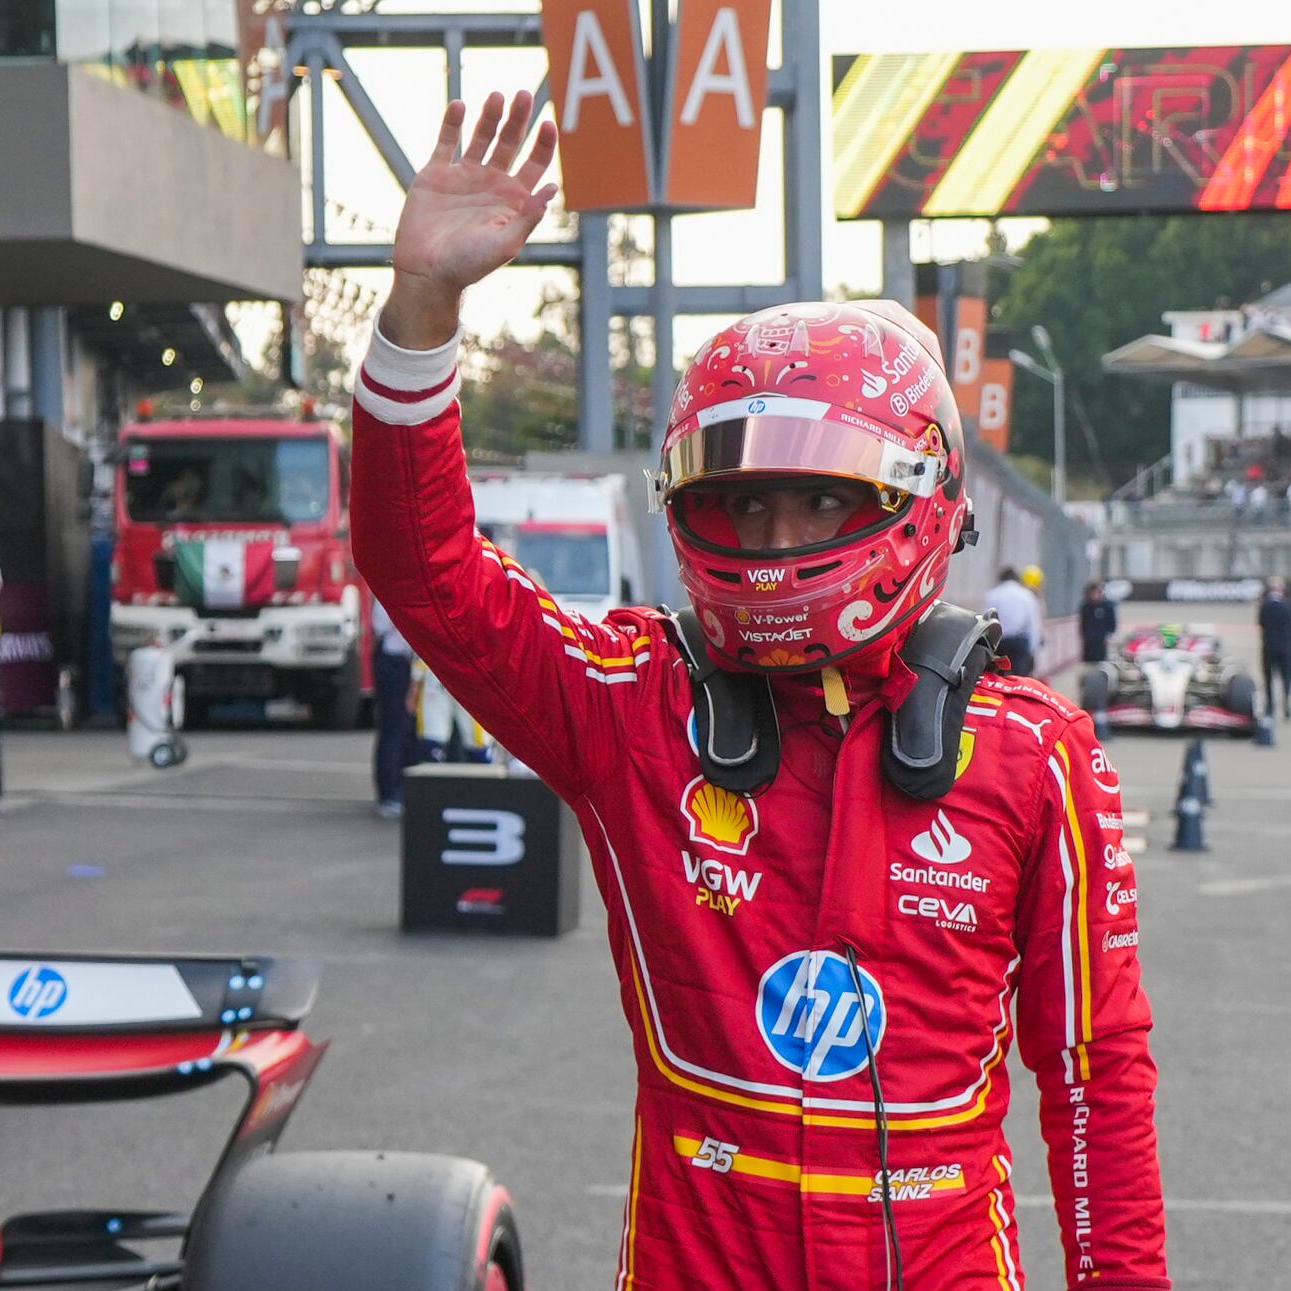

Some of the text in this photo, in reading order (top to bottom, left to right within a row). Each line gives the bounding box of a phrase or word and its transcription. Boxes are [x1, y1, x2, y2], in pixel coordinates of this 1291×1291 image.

[561, 9, 635, 134] A
[680, 6, 756, 130] A
[954, 328, 980, 384] B
[979, 383, 1008, 429] B
[840, 412, 907, 447] RICHARD MILLE
[747, 568, 786, 583] VGW
[755, 582, 778, 592] PLAY
[738, 627, 814, 643] VISTAJET
[752, 611, 809, 625] V-Power
[440, 807, 526, 866] 3
[680, 850, 763, 902] VGW
[889, 862, 991, 894] Santander
[695, 886, 742, 917] PLAY
[935, 918, 977, 933] LOGISTICS
[8, 965, 67, 1018] hp
[761, 952, 881, 1079] hp
[692, 1136, 740, 1174] 55
[874, 1163, 961, 1185] CARLOS
[867, 1183, 934, 1203] SAINZ
[1075, 1196, 1093, 1271] MILLE
